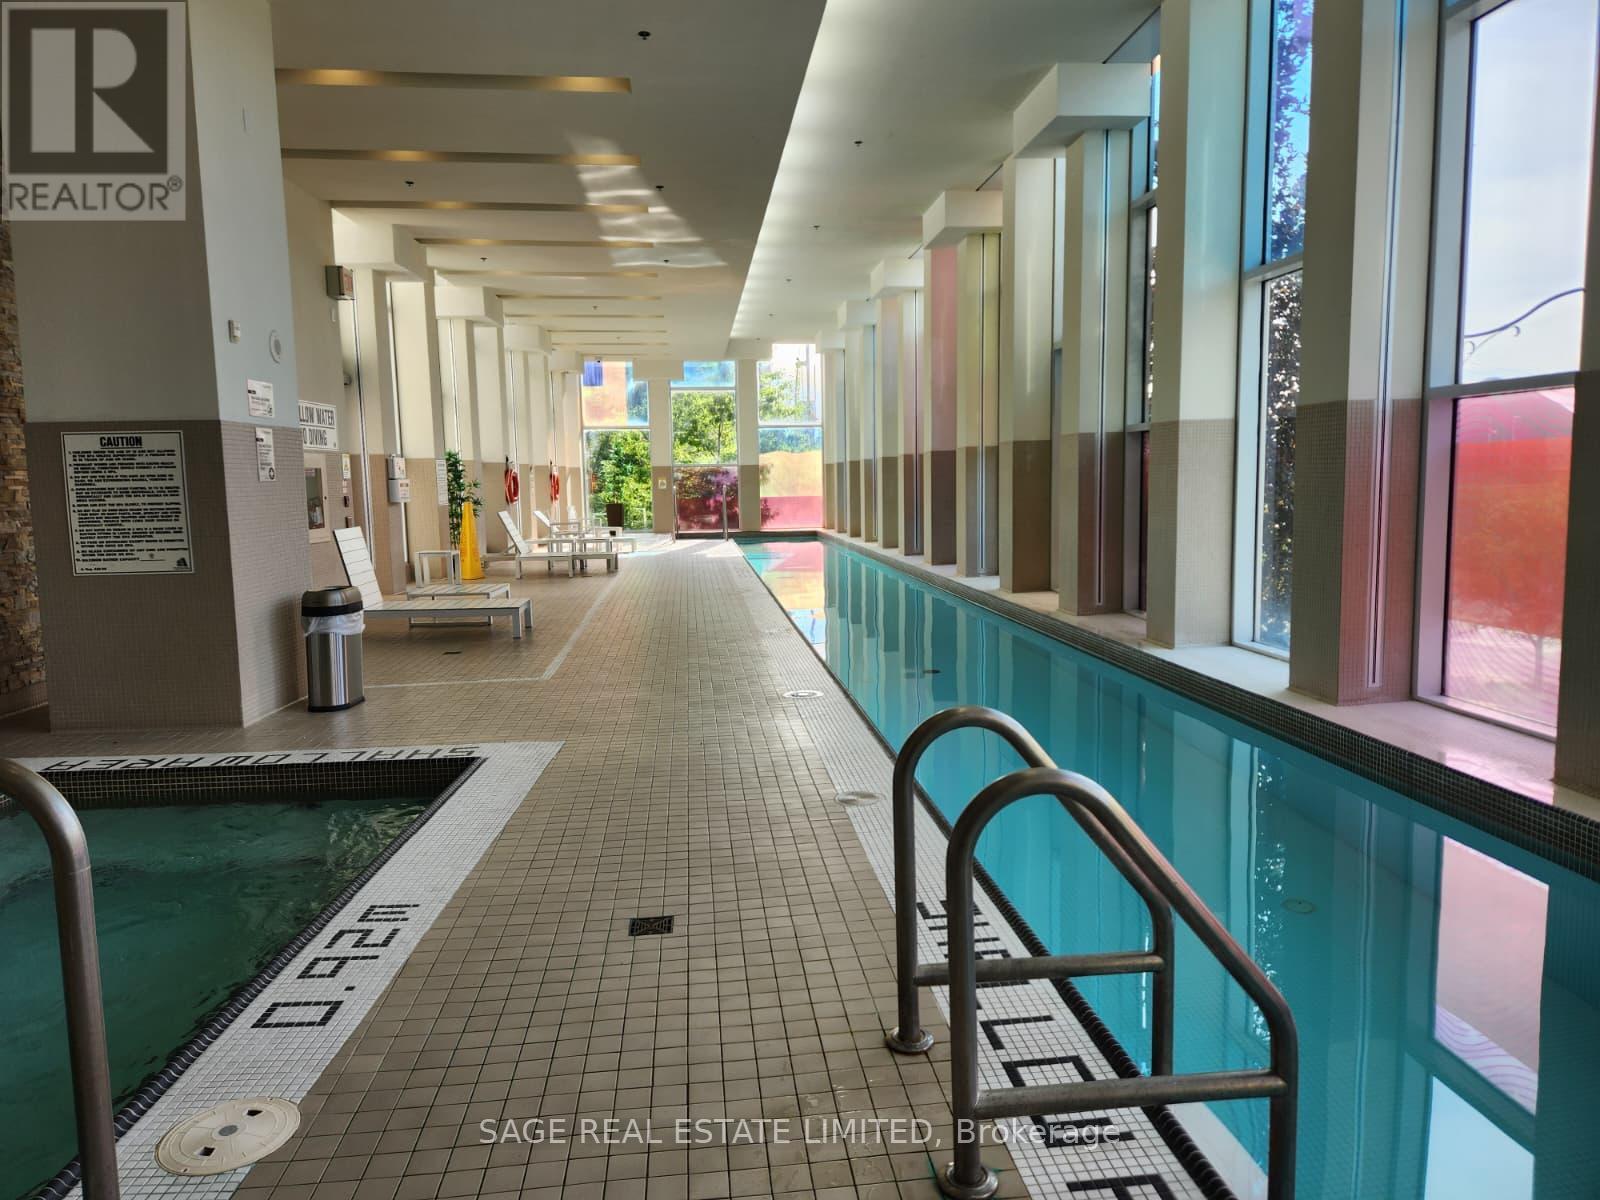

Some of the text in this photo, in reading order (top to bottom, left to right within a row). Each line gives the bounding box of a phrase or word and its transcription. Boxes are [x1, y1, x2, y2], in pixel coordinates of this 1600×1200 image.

[298, 404, 335, 426] LLOW WATER
[99, 436, 142, 448] CAUTION
[308, 428, 327, 446] DIVING
